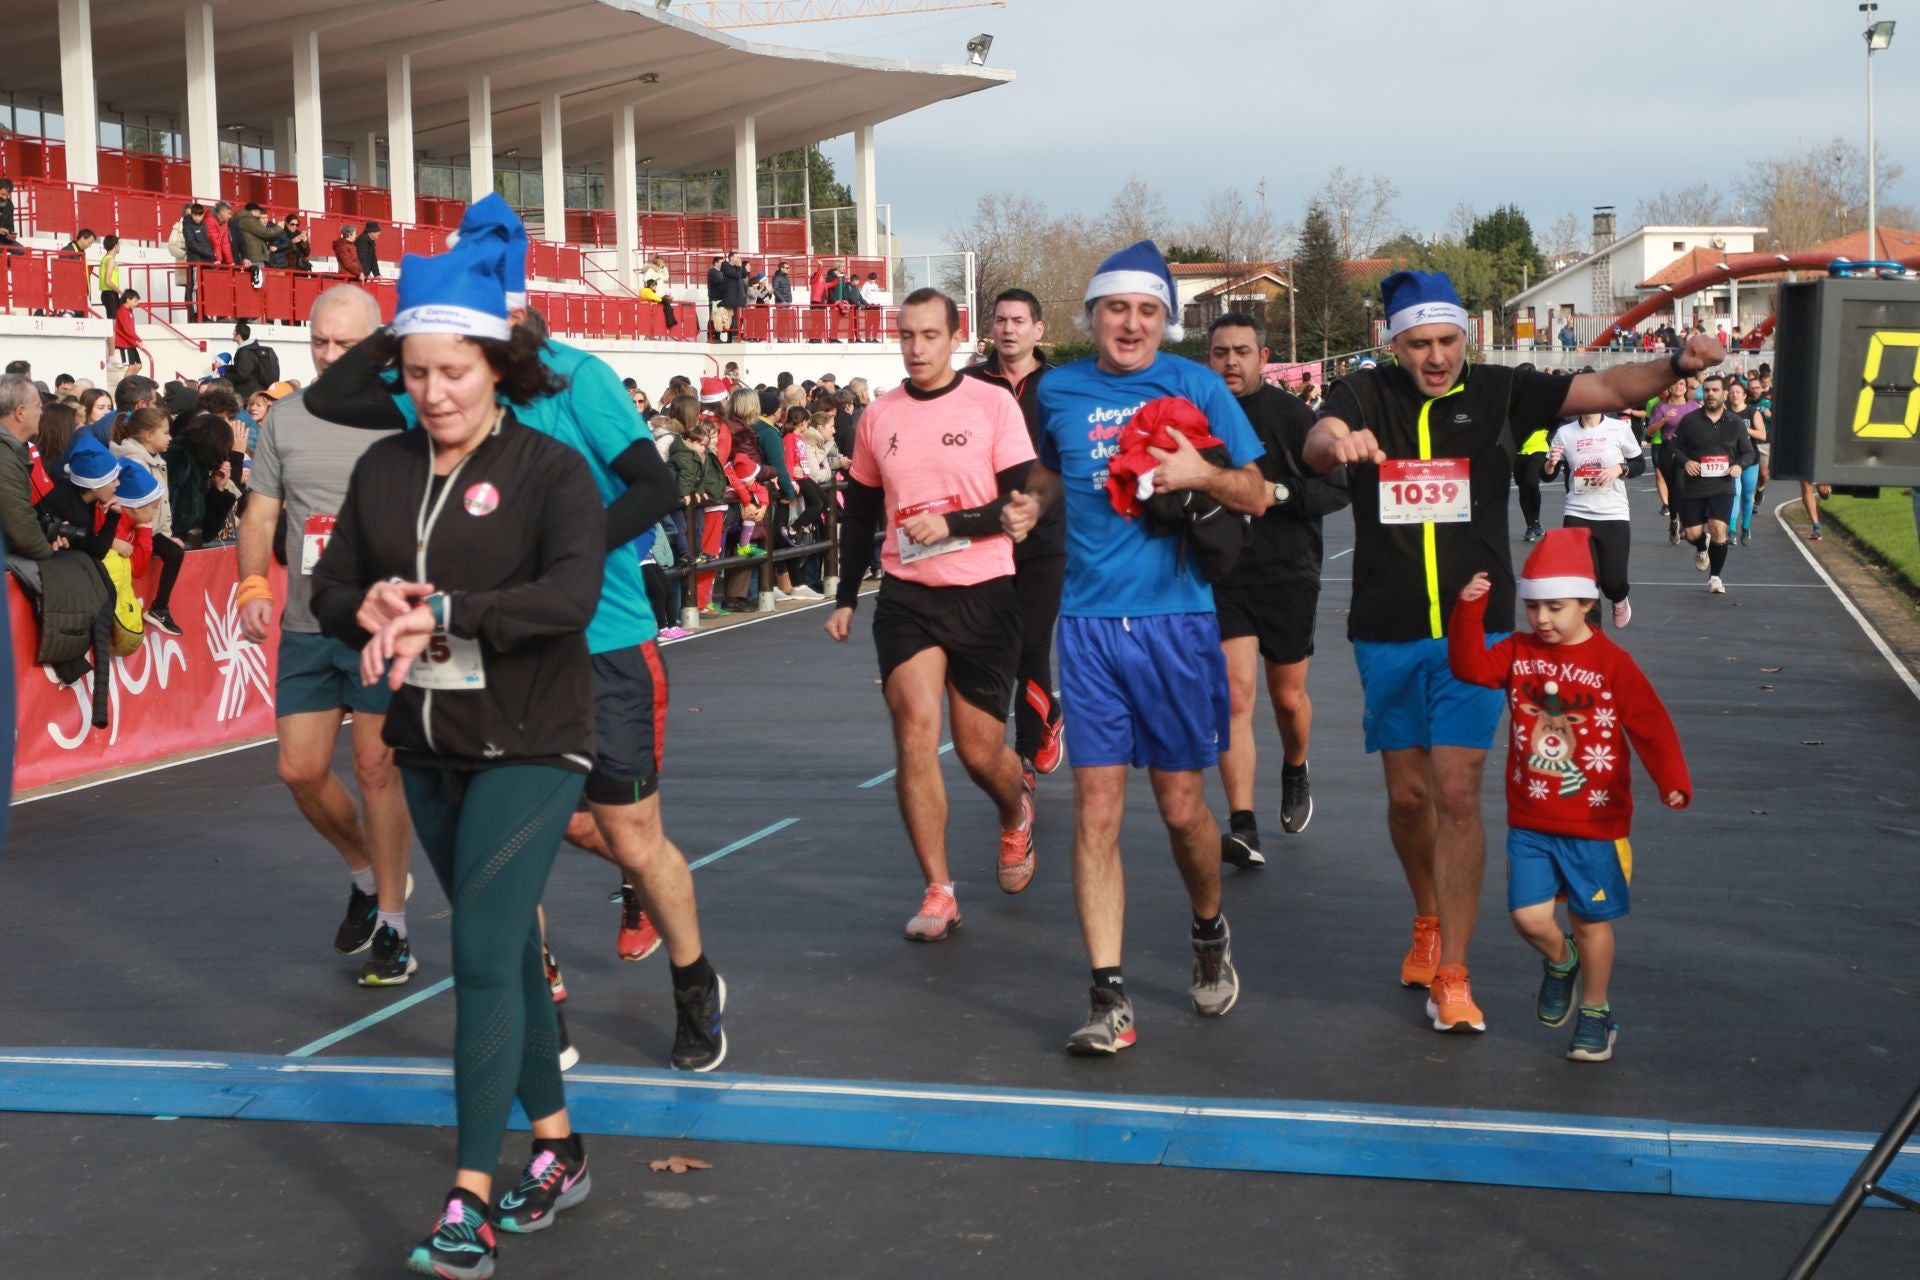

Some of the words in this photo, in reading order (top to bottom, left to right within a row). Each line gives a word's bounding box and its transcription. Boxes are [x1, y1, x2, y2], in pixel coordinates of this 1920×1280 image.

[941, 433, 967, 446] GO
[1706, 463, 1725, 471] 1175
[1391, 482, 1459, 505] 1039
